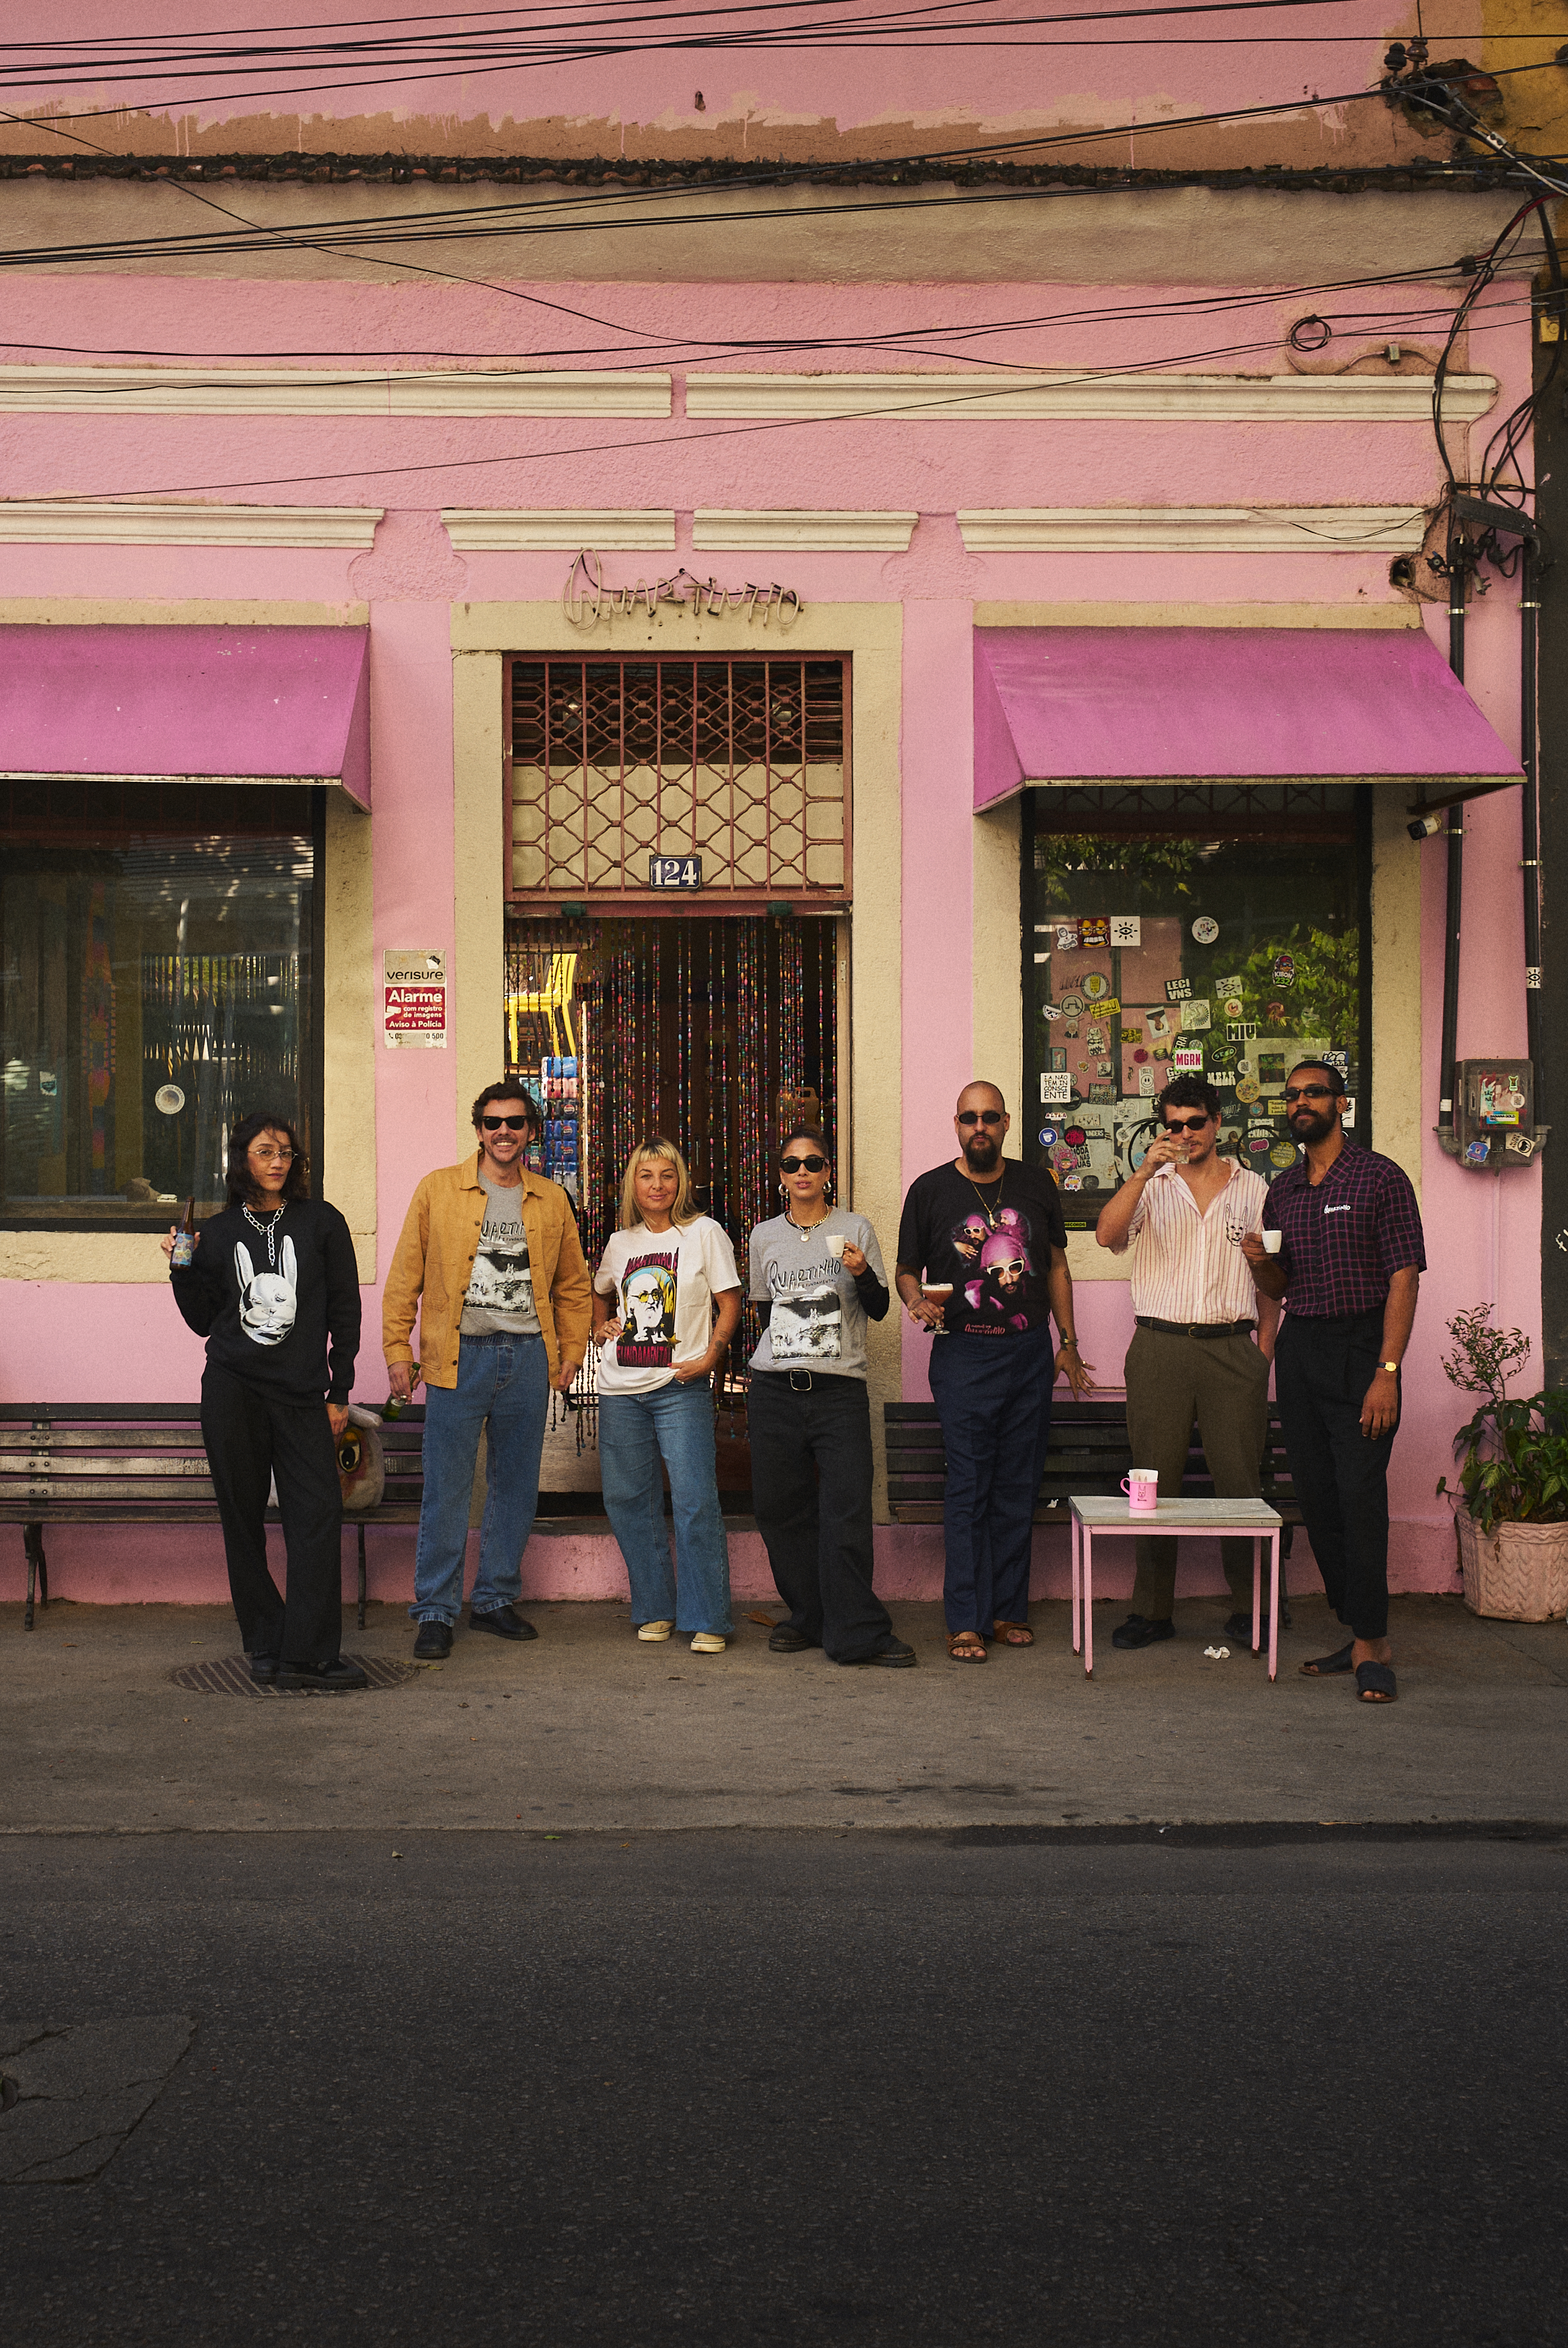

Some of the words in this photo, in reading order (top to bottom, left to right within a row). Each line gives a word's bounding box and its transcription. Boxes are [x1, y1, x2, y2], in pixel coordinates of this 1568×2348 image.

[653, 859, 697, 886] 124
[386, 971, 443, 980] verisure
[1275, 977, 1290, 986] 232
[1166, 978, 1190, 990] LECI
[388, 989, 443, 1003] Alarme
[1168, 988, 1192, 1000] VNS
[1228, 1024, 1255, 1040] MIU
[1176, 1053, 1201, 1066] MGRN
[1207, 1071, 1236, 1086] MELK
